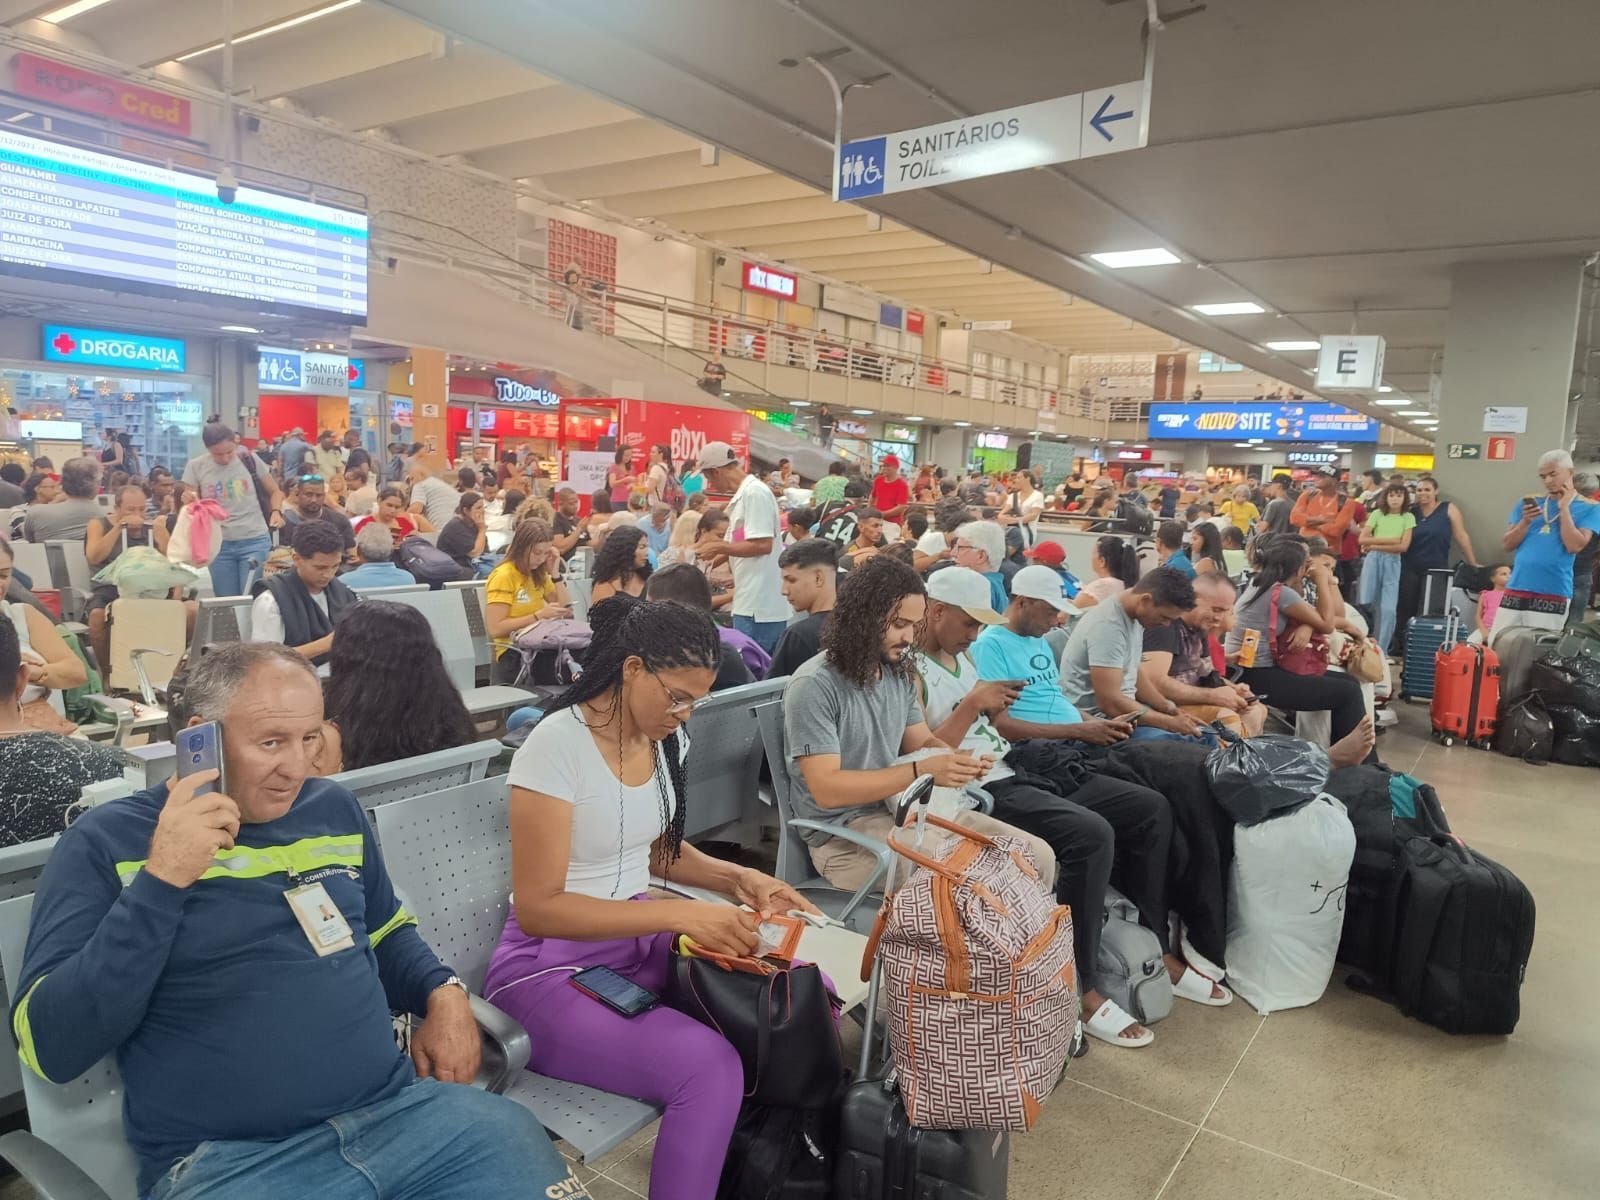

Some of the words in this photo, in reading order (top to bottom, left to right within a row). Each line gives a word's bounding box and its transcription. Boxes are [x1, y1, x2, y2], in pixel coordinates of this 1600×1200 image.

[121, 92, 182, 124] Cred
[899, 118, 1020, 159] SANITÁRIOS
[0, 151, 47, 168] DESTINO
[111, 176, 152, 191] DESTINO
[0, 163, 57, 182] GUANAMBI
[1, 186, 73, 208] CONSELHEIRO
[75, 200, 120, 217] LAFAIETE
[1, 210, 26, 222] JUIZ
[28, 215, 42, 226] DE
[44, 218, 72, 230] FORA
[176, 201, 215, 216] EMPRESA
[217, 209, 251, 223] GONTIJO
[252, 216, 263, 225] DE
[264, 219, 316, 236] TRANSPORTES
[2, 233, 65, 251] BARBACENA
[176, 221, 209, 235] VIAÇÃO
[210, 227, 244, 242] SANDRA
[245, 235, 265, 246] LTDA
[177, 242, 228, 259] COMPANHIA
[229, 251, 254, 263] ATUAL
[255, 256, 266, 265] DE
[267, 258, 318, 275] TRANSPORTES
[177, 262, 228, 279] COMPANHIA
[229, 271, 254, 284] ATUAL
[255, 276, 266, 285] DE
[267, 278, 318, 294] TRANSPORTES
[81, 339, 179, 364] DROGARIA
[1336, 350, 1358, 373] E
[305, 375, 345, 388] TOILETS
[495, 378, 532, 401] TUDO
[1198, 412, 1238, 430] NOVO
[1240, 412, 1272, 430] SITE
[1288, 453, 1337, 462] SPOLETO
[825, 518, 857, 545] 34
[1529, 598, 1566, 613] LACOSTE
